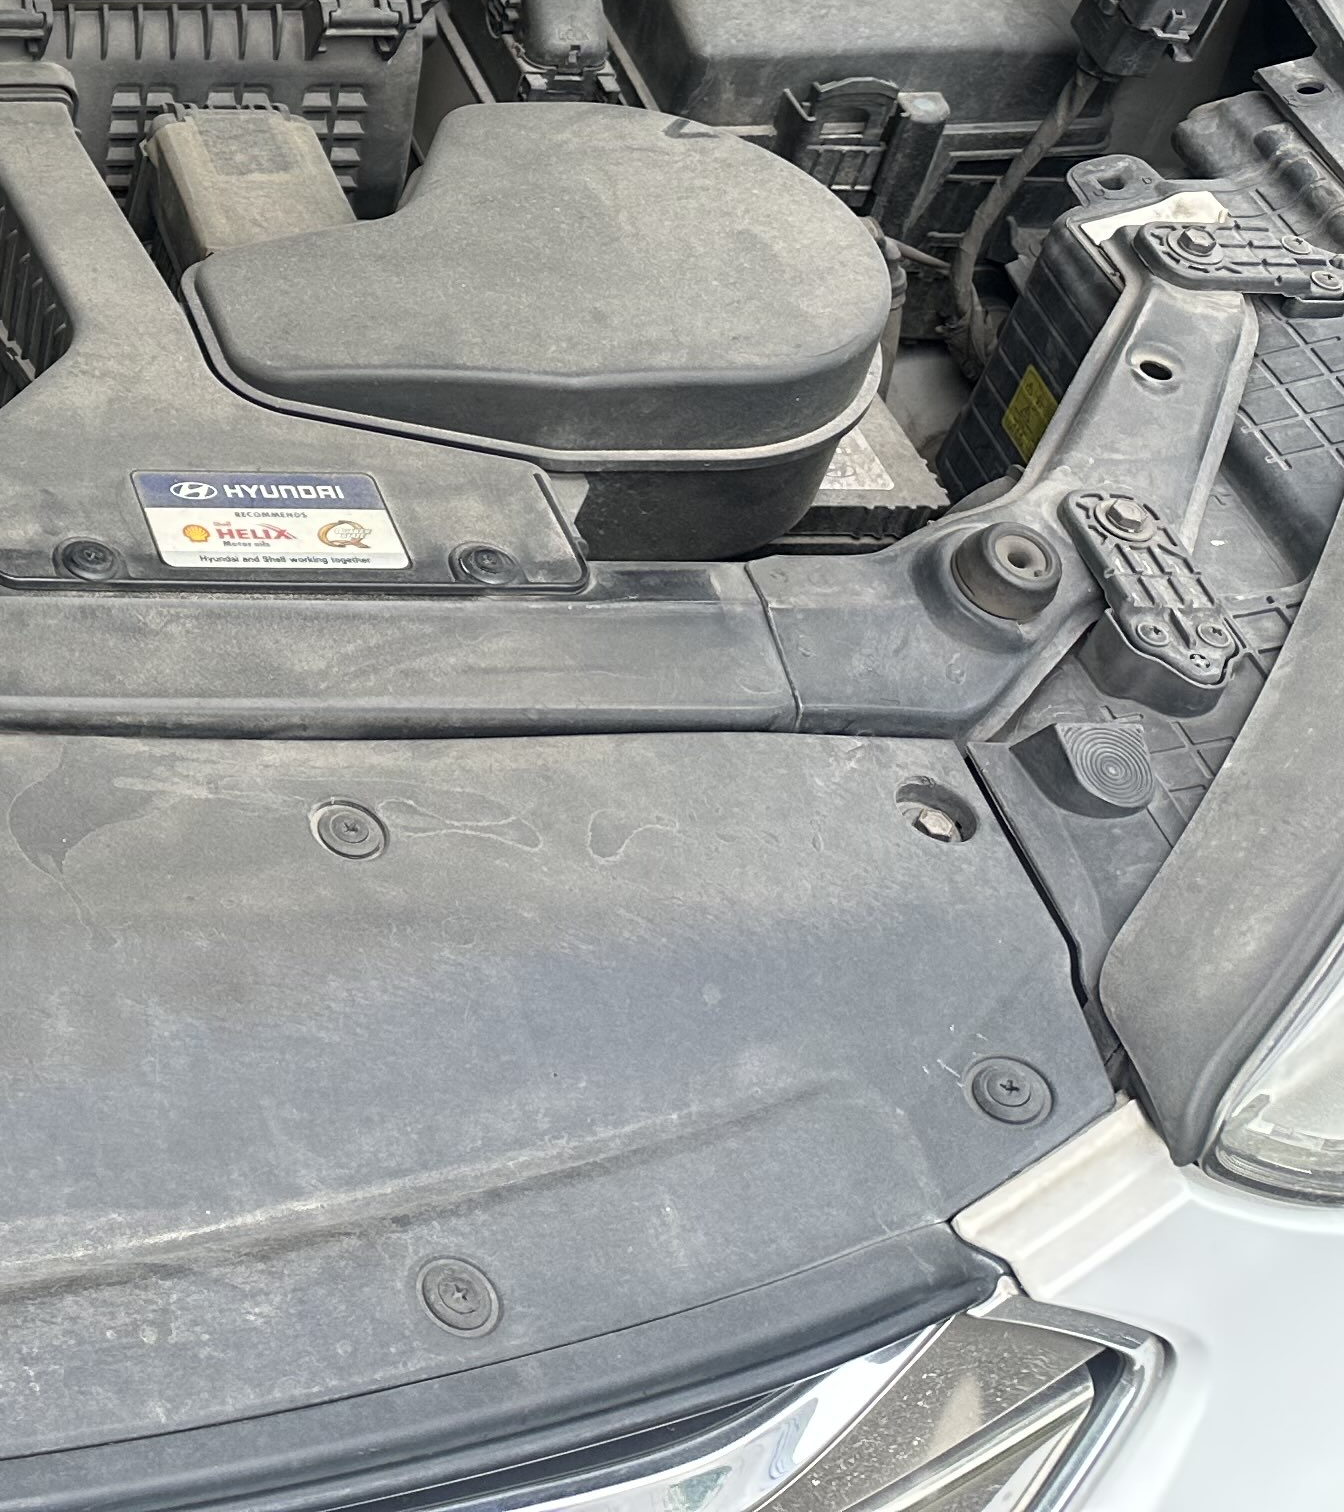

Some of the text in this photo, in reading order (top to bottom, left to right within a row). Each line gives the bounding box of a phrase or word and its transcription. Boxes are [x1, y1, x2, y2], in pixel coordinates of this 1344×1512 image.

[223, 483, 345, 500] HYUNDAI
[234, 510, 308, 519] RECOMMENDS
[216, 528, 297, 540] HELIX
[199, 554, 371, 565] Hyundai and Shell working together
